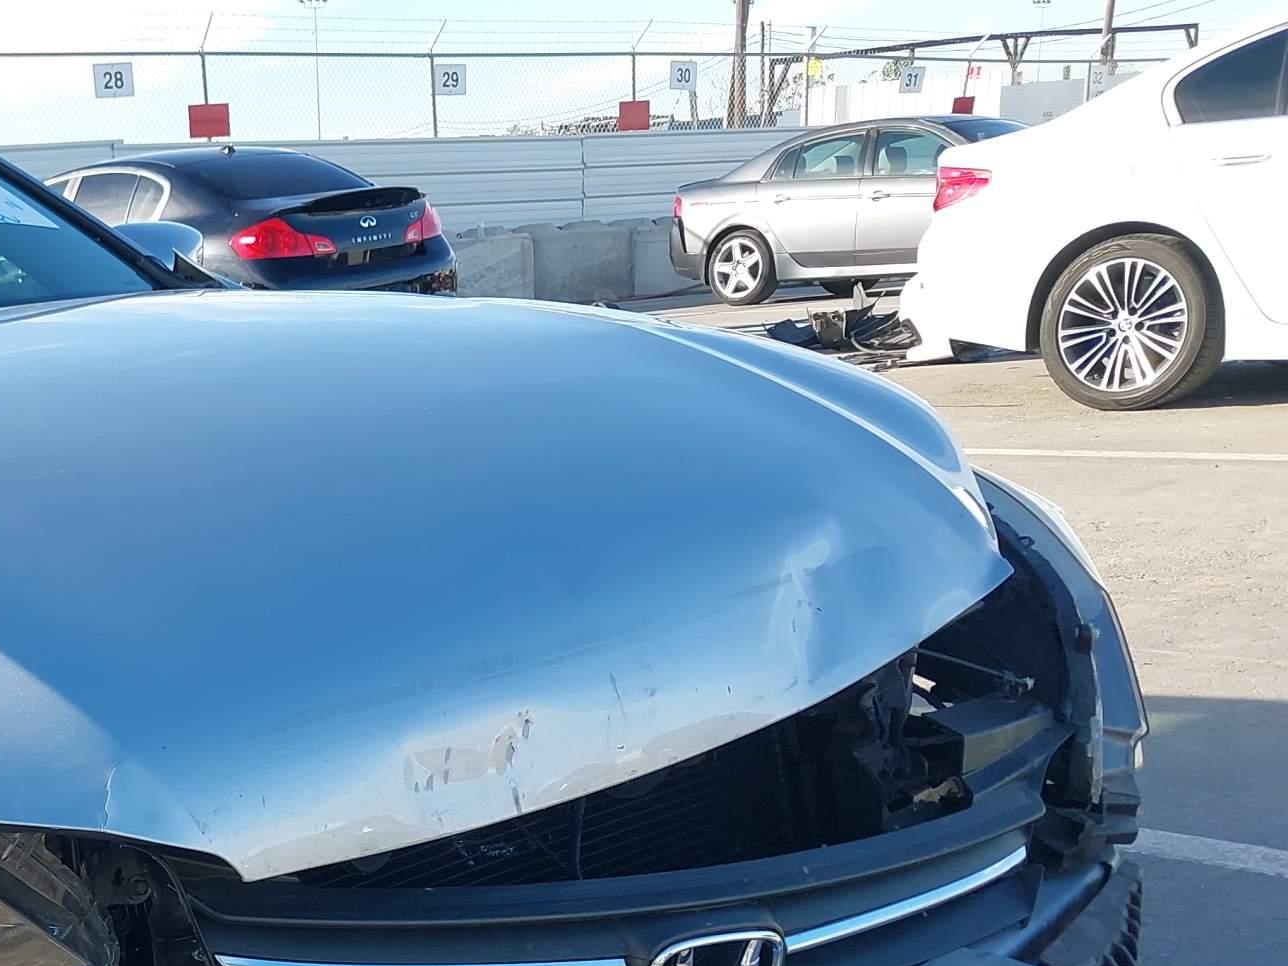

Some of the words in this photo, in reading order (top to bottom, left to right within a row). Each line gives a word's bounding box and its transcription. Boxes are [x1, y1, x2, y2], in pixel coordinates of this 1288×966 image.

[103, 70, 124, 89] 28
[442, 71, 459, 88] 29
[676, 67, 691, 83] 30
[905, 72, 919, 87] 31
[1092, 71, 1103, 84] 32
[352, 232, 392, 244] INFINITI
